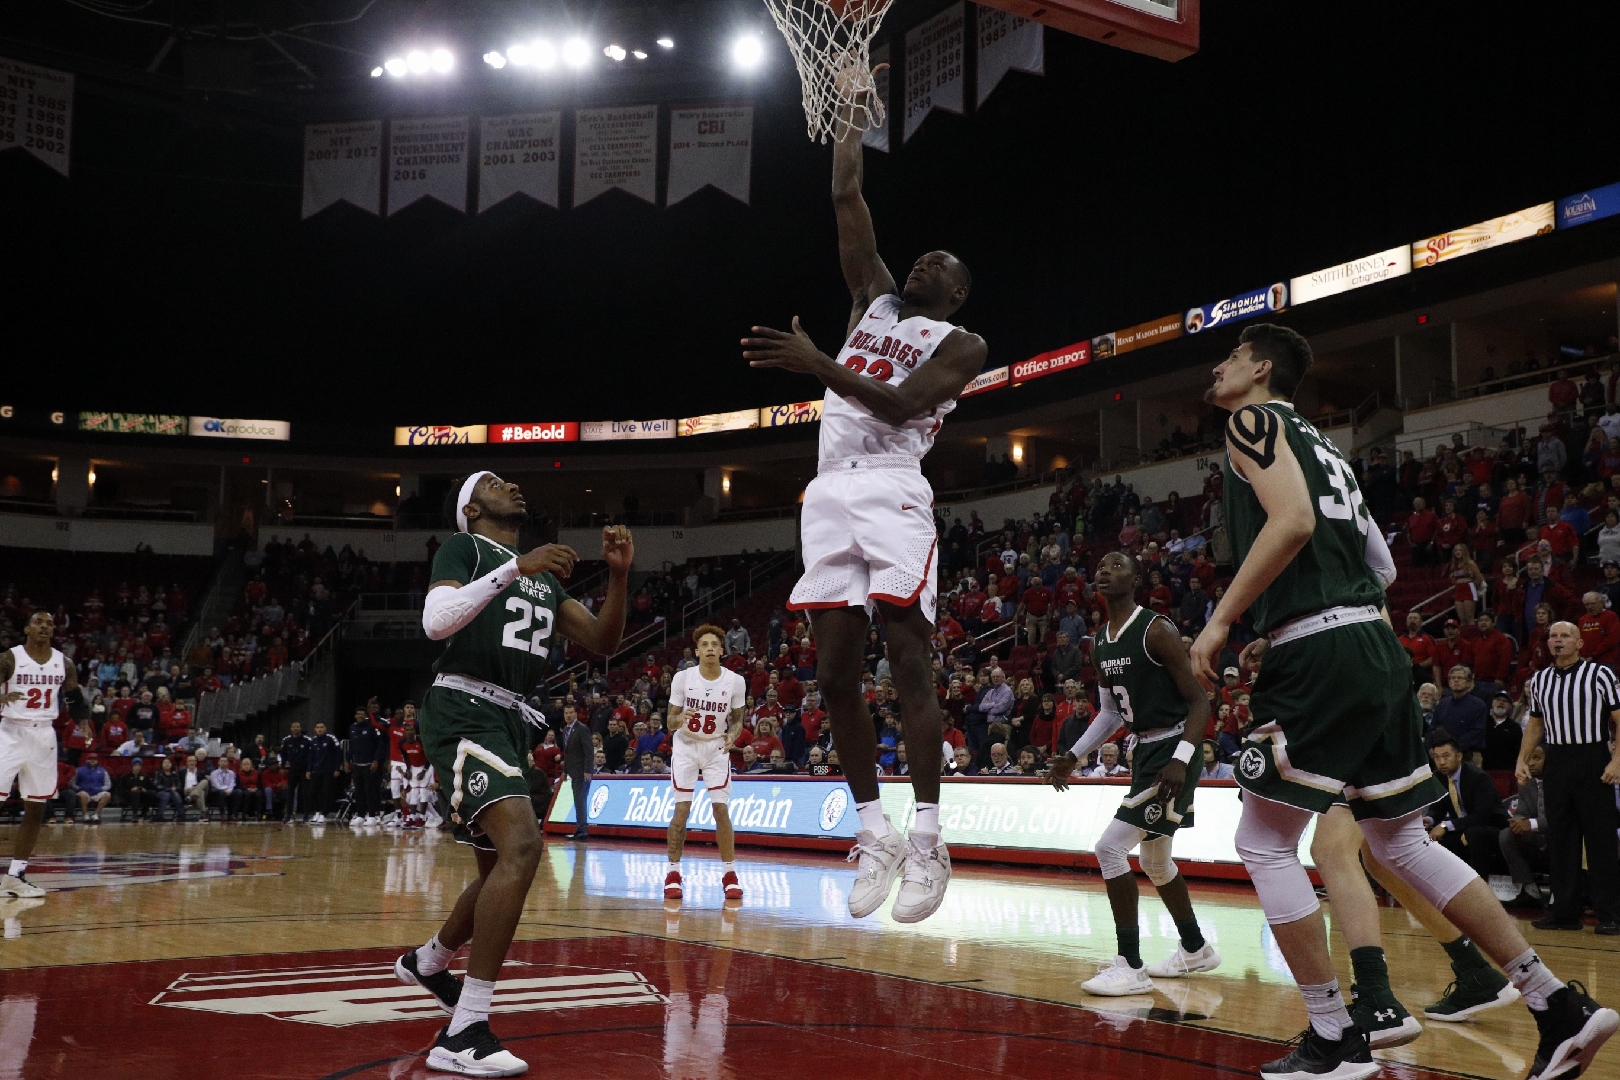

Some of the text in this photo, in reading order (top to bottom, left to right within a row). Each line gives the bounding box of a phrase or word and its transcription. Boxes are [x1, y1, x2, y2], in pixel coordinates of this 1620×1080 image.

[981, 24, 1006, 49] 1985
[908, 32, 962, 71] 1993 1994
[908, 48, 961, 87] 1995 1996
[7, 75, 36, 90] NIT
[908, 64, 961, 102] 1997 1998
[27, 94, 66, 111] 1985
[27, 107, 65, 125] 1996
[25, 122, 64, 140] 1998
[507, 127, 534, 138] WAC
[697, 120, 726, 135] CBI
[25, 135, 65, 154] 2002
[330, 137, 351, 146] NIT
[393, 142, 465, 155] TOURNAMENT
[486, 137, 555, 151] CHAMPIONS
[307, 146, 378, 161] 2007 2017
[396, 154, 461, 166] CHAMPIONS
[484, 151, 556, 166] 2001 2003
[394, 169, 426, 181] 2016
[1345, 256, 1387, 277] BARNEY
[1352, 268, 1390, 285] citigroup
[1222, 293, 1266, 312] SIMONIAN
[1117, 335, 1135, 346] HENRY
[848, 330, 924, 369] BULLDOGS
[1014, 350, 1087, 378] Office DEPOT
[0, 406, 13, 418] G
[51, 412, 64, 424] G
[203, 420, 275, 436] OK produce
[502, 425, 565, 441] #BeBold
[612, 421, 668, 433] Live Well
[939, 506, 951, 517] 125
[672, 530, 684, 540] 126
[519, 582, 546, 601] STATE
[502, 596, 554, 660] 22
[1104, 666, 1124, 677] STATE
[26, 688, 53, 709] 21
[686, 697, 728, 713] BULLDOGS
[813, 765, 829, 774] POSS
[690, 787, 793, 828] Montain
[900, 796, 1092, 837] tcasino.com
